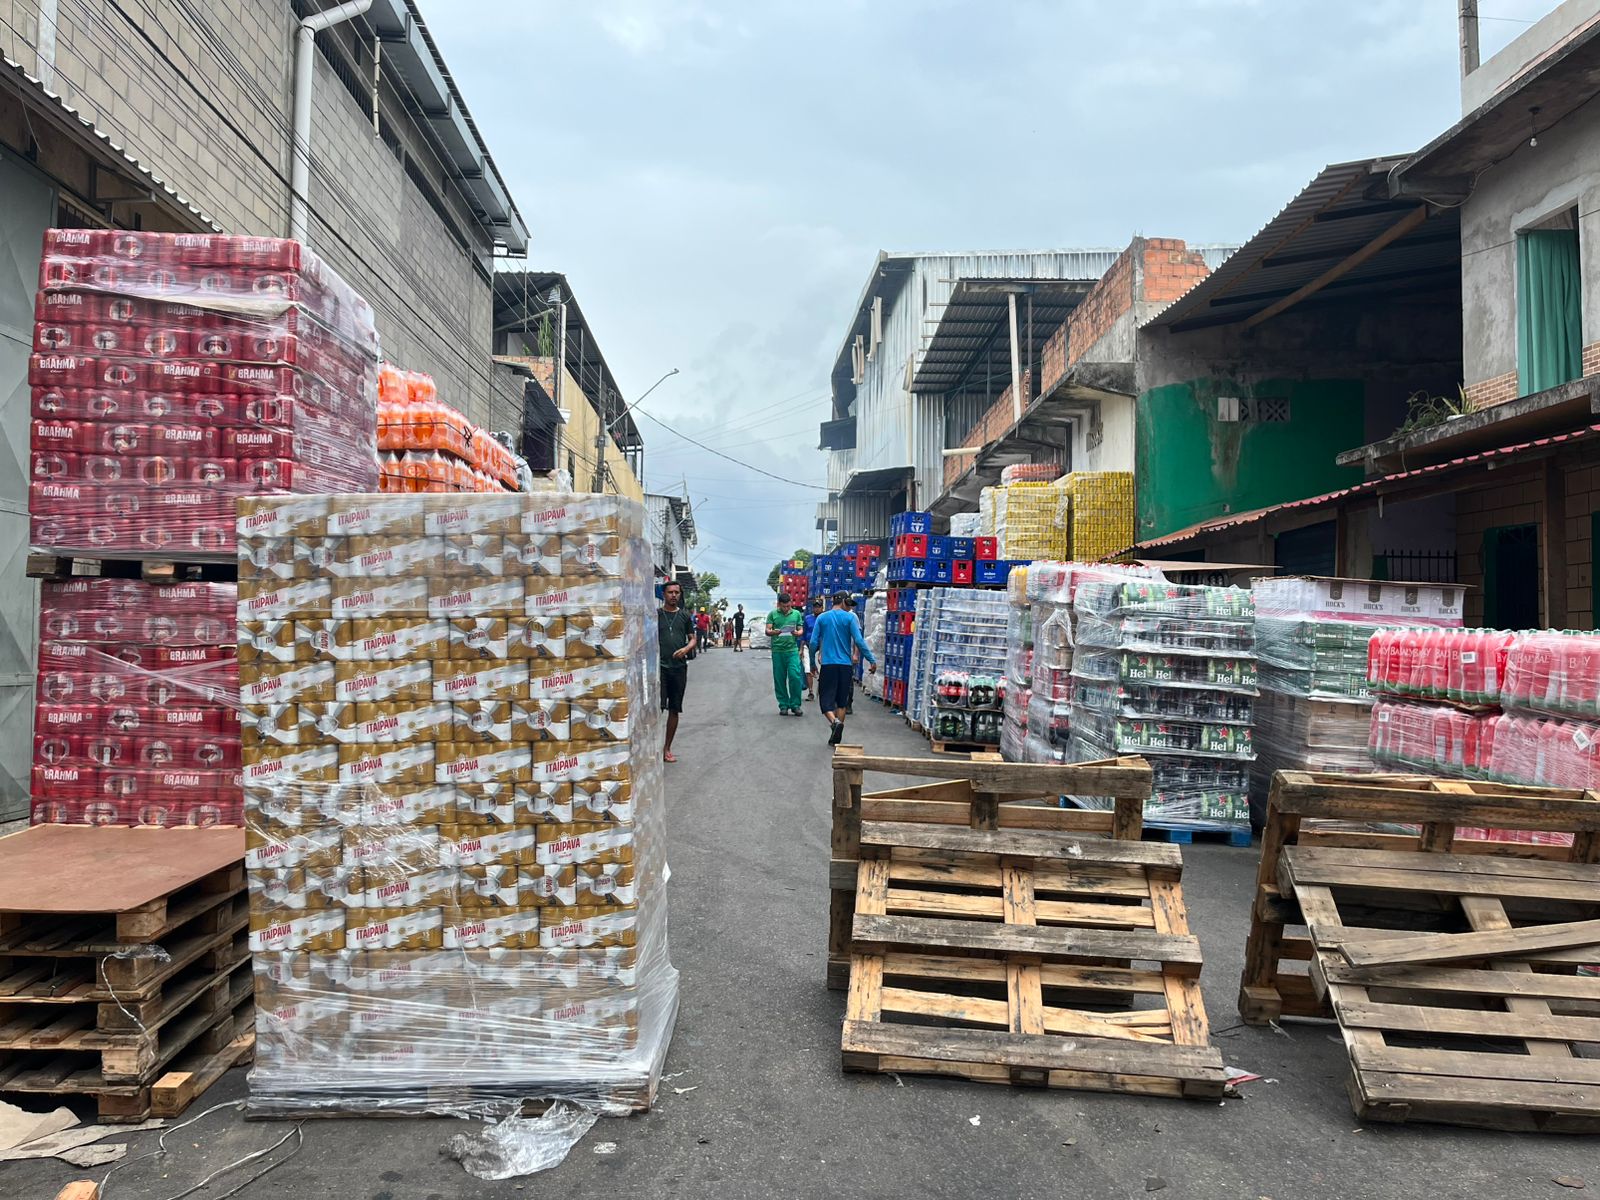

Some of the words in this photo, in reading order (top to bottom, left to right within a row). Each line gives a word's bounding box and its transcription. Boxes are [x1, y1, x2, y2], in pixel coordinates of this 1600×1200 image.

[56, 232, 90, 244] BRAHMA
[174, 237, 210, 248] BRAHMA
[242, 241, 280, 252] BRAHMA
[48, 294, 82, 304] BRAHMA
[40, 359, 75, 369] BRAHMA
[164, 365, 200, 376] BRAHMA
[238, 368, 274, 379] BRAHMA
[38, 426, 73, 438] BRAHMA
[165, 429, 202, 440] BRAHMA
[237, 434, 273, 444] BRAHMA
[43, 485, 80, 499] BRAHMA
[165, 493, 202, 505] BRAHMA
[246, 512, 278, 528] ITAIPAVA
[338, 509, 370, 526] ITAIPAVA
[436, 510, 469, 525] ITAIPAVA
[534, 508, 566, 523] ITAIPAVA
[360, 550, 393, 567] ITAIPAVA
[53, 582, 87, 592] BRAHMA
[159, 588, 196, 598] BRAHMA
[248, 594, 279, 610] ITAIPAVA
[342, 592, 374, 609] ITAIPAVA
[440, 592, 472, 608] ITAIPAVA
[535, 591, 568, 607] ITAIPAVA
[1216, 606, 1231, 615] Hei
[364, 634, 396, 651] ITAIPAVA
[52, 646, 86, 656] BRAHMA
[170, 650, 206, 660] BRAHMA
[1130, 669, 1146, 678] Hei
[1156, 671, 1171, 680] Hei
[1217, 674, 1233, 683] Hei
[251, 678, 282, 696] ITAIPAVA
[345, 676, 378, 693] ITAIPAVA
[445, 676, 477, 692] ITAIPAVA
[541, 673, 574, 689] ITAIPAVA
[48, 712, 83, 722] BRAHMA
[167, 712, 203, 722] BRAHMA
[366, 718, 398, 734] ITAIPAVA
[1124, 737, 1140, 745] Hei
[1150, 738, 1166, 747] Hei
[1211, 742, 1226, 751] Hei
[1236, 744, 1251, 753] Hei
[250, 761, 282, 777] ITAIPAVA
[350, 758, 382, 774] ITAIPAVA
[446, 760, 478, 775] ITAIPAVA
[545, 757, 578, 774] ITAIPAVA
[45, 770, 78, 780] BRAHMA
[164, 775, 199, 785] BRAHMA
[1211, 809, 1226, 818] Hei
[548, 838, 580, 854] ITAIPAVA
[377, 882, 410, 899] ITAIPAVA
[260, 924, 292, 942] ITAIPAVA
[356, 924, 389, 940] ITAIPAVA
[454, 923, 486, 938] ITAIPAVA
[551, 923, 583, 938] ITAIPAVA
[554, 1004, 586, 1020] ITAIPAVA
